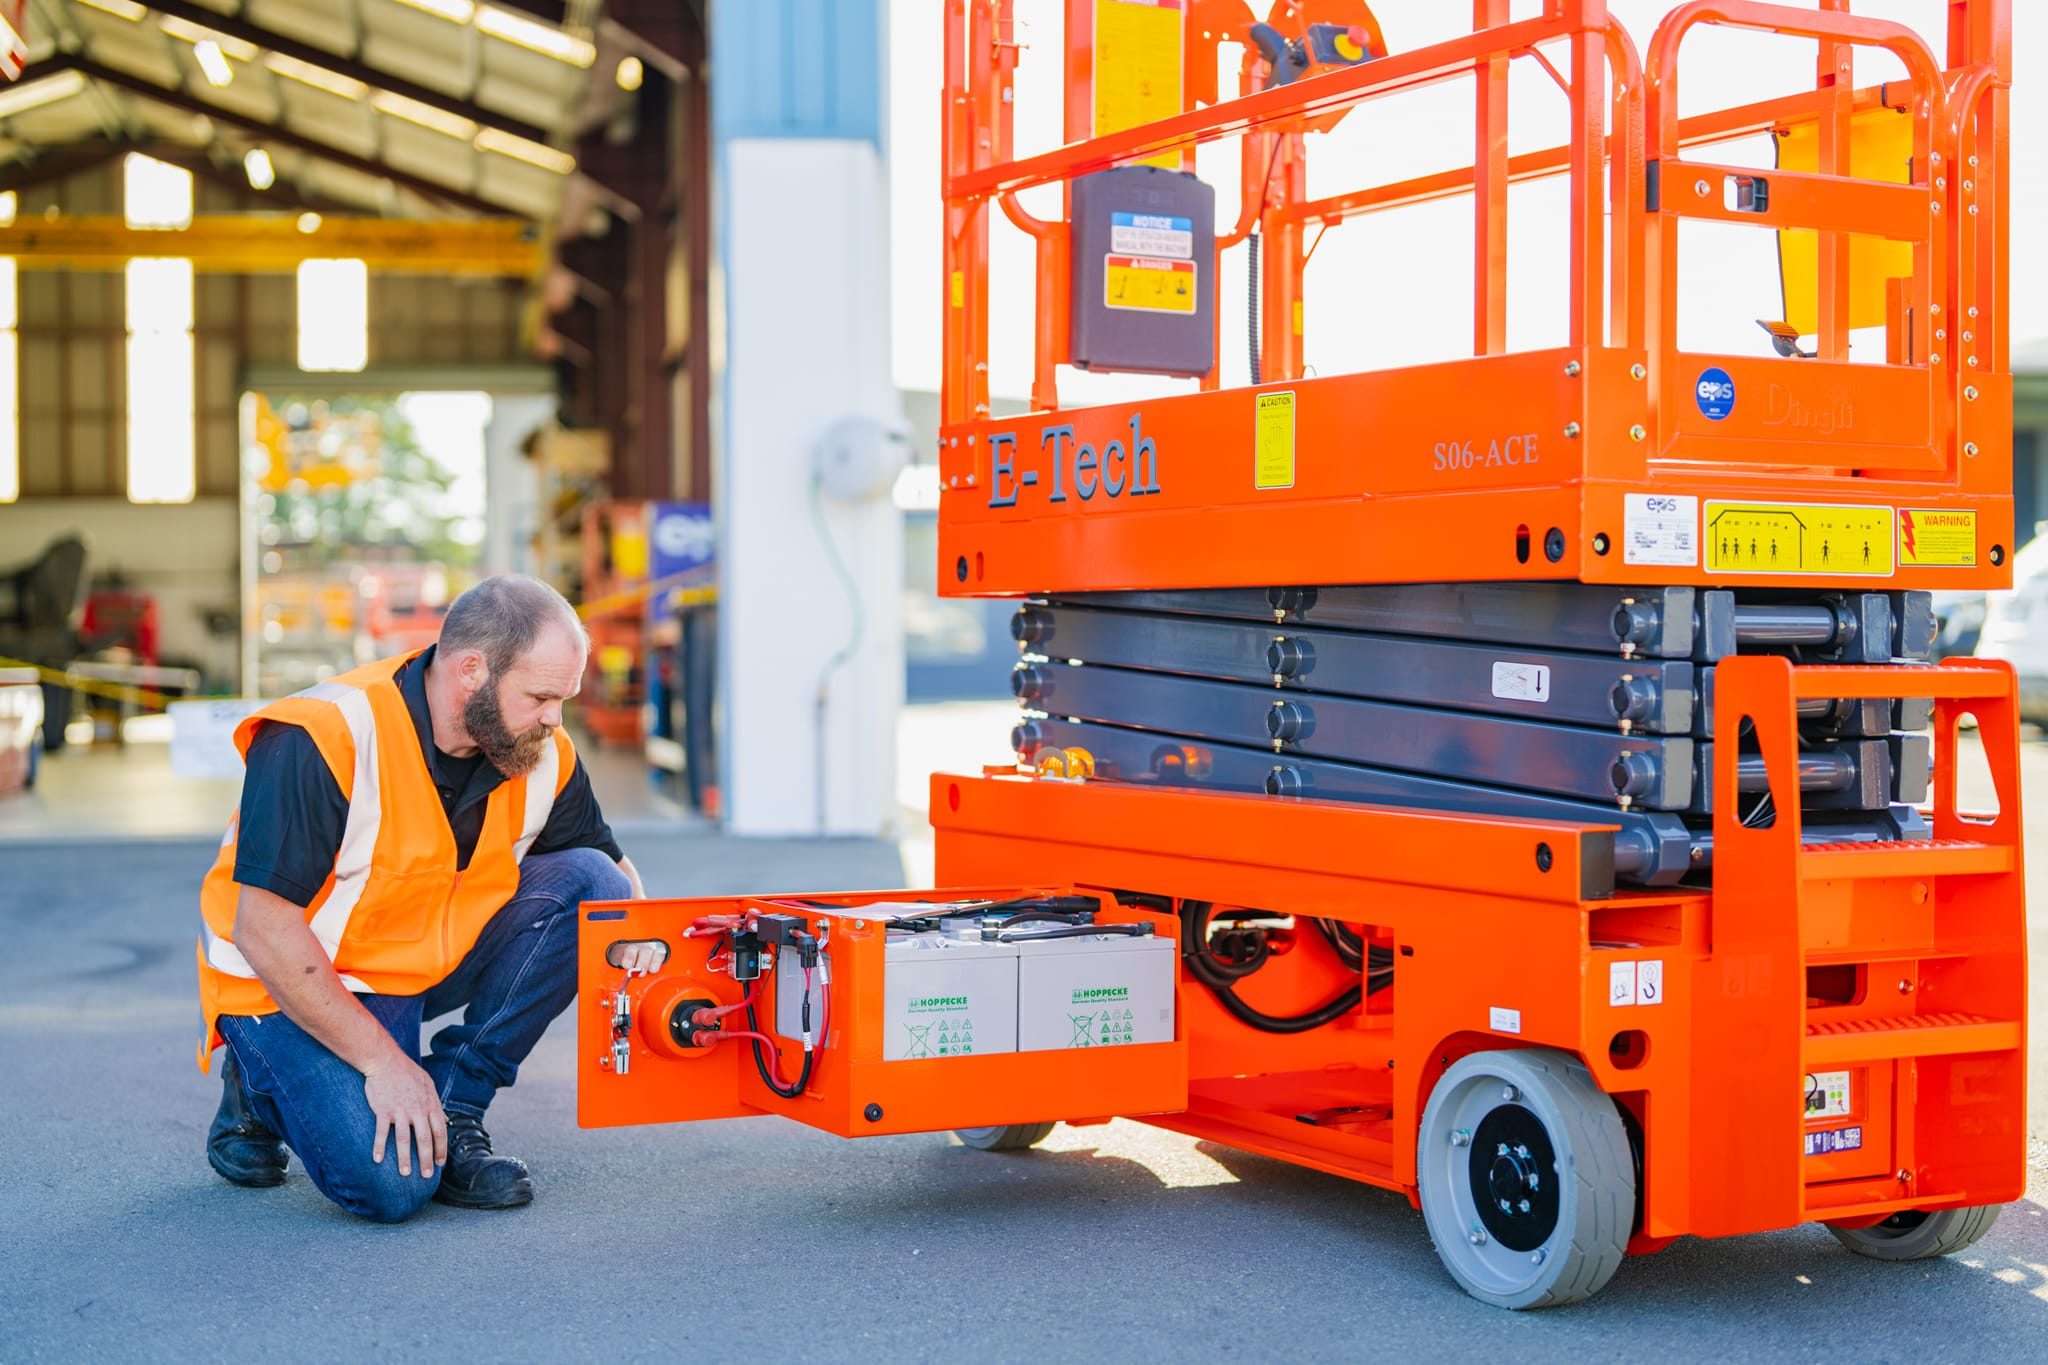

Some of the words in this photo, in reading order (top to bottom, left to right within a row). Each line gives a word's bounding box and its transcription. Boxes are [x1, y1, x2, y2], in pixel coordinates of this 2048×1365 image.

[1132, 215, 1171, 230] NOTICE
[1266, 396, 1291, 407] CAUTION
[1432, 433, 1540, 472] S06-ACE
[987, 412, 1161, 509] E-Tech
[1923, 515, 1971, 527] WARNING
[1083, 987, 1129, 998] HOPPECKE
[920, 996, 968, 1007] HOPPECKE
